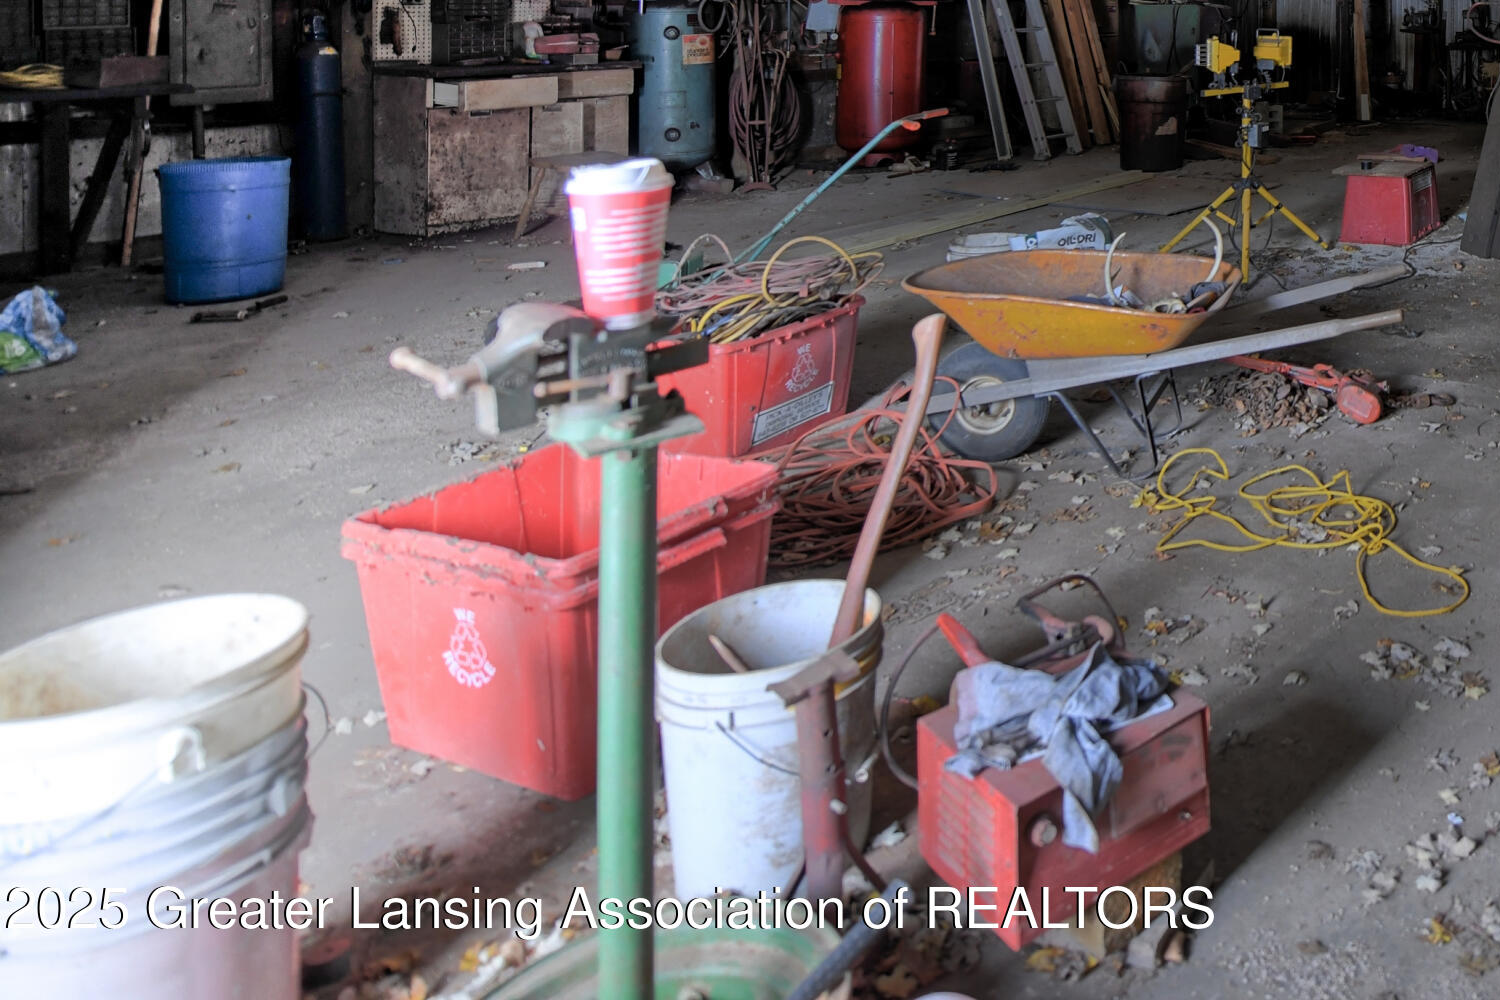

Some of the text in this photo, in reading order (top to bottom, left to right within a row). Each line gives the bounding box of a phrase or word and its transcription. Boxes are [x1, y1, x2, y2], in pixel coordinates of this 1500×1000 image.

[797, 343, 811, 355] WE
[453, 608, 475, 625] WE
[442, 650, 496, 688] RECYCLE
